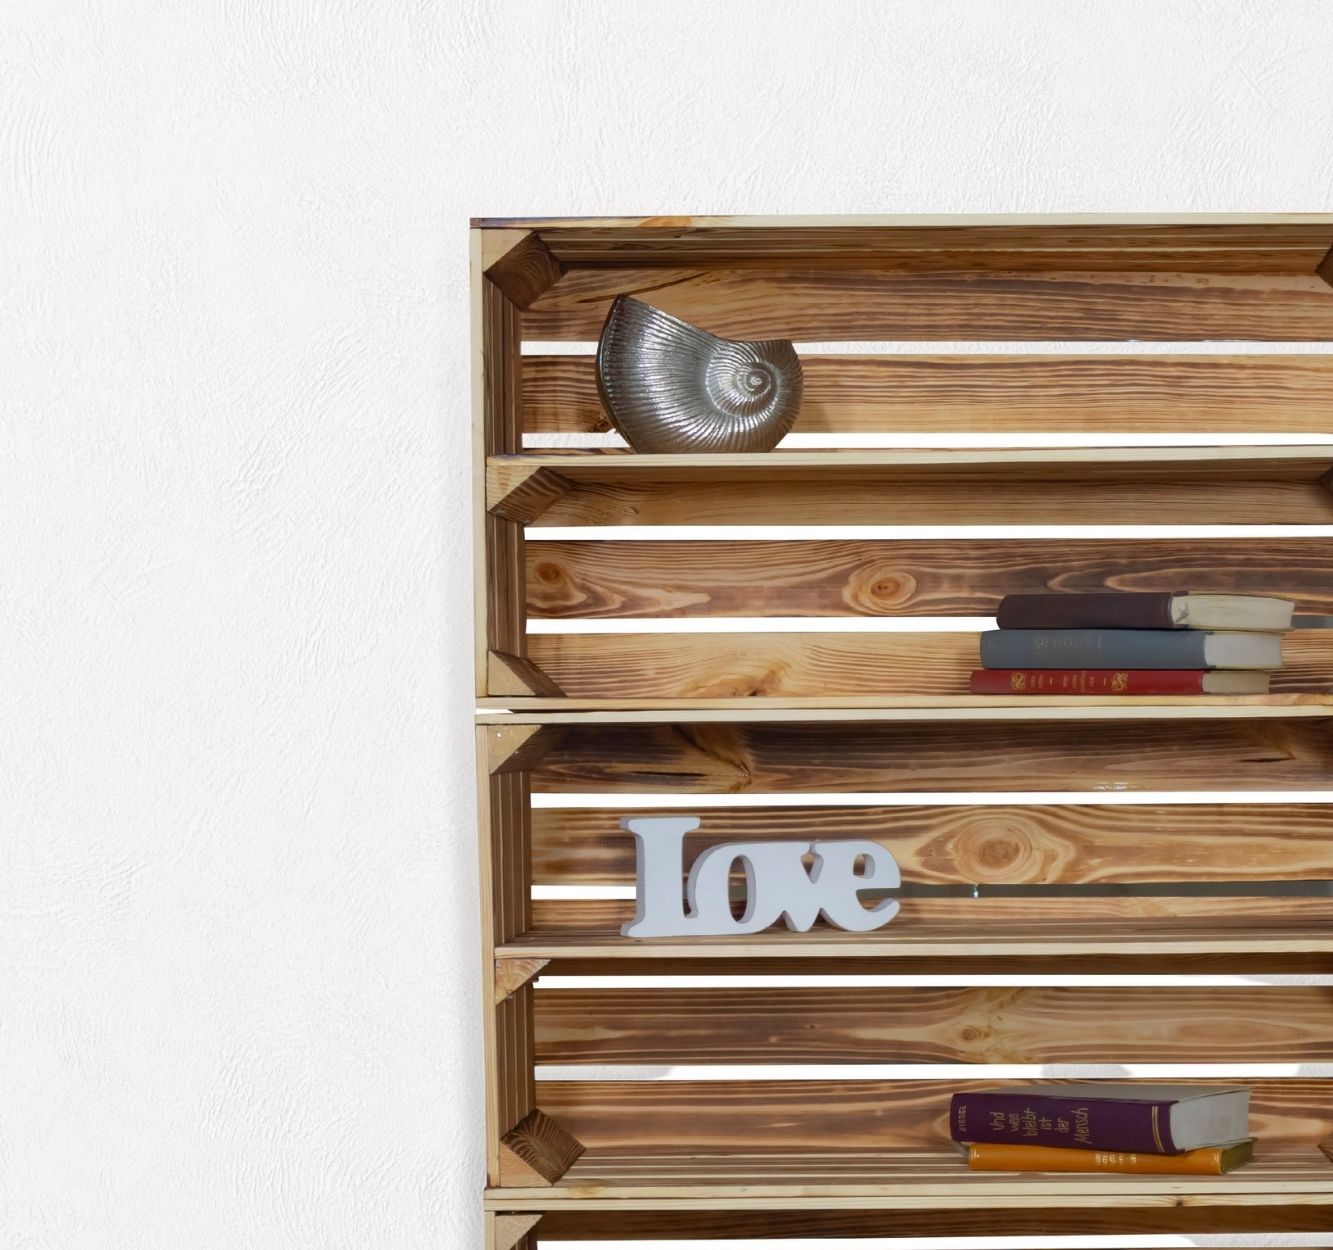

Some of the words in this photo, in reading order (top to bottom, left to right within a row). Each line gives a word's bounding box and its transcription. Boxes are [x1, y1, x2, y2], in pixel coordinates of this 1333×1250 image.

[620, 817, 901, 938] Love
[991, 1112, 1005, 1131] Und
[1023, 1107, 1038, 1136] bleibt
[1039, 1116, 1053, 1131] ist
[1054, 1117, 1070, 1134] der
[1072, 1108, 1093, 1144] Mensch
